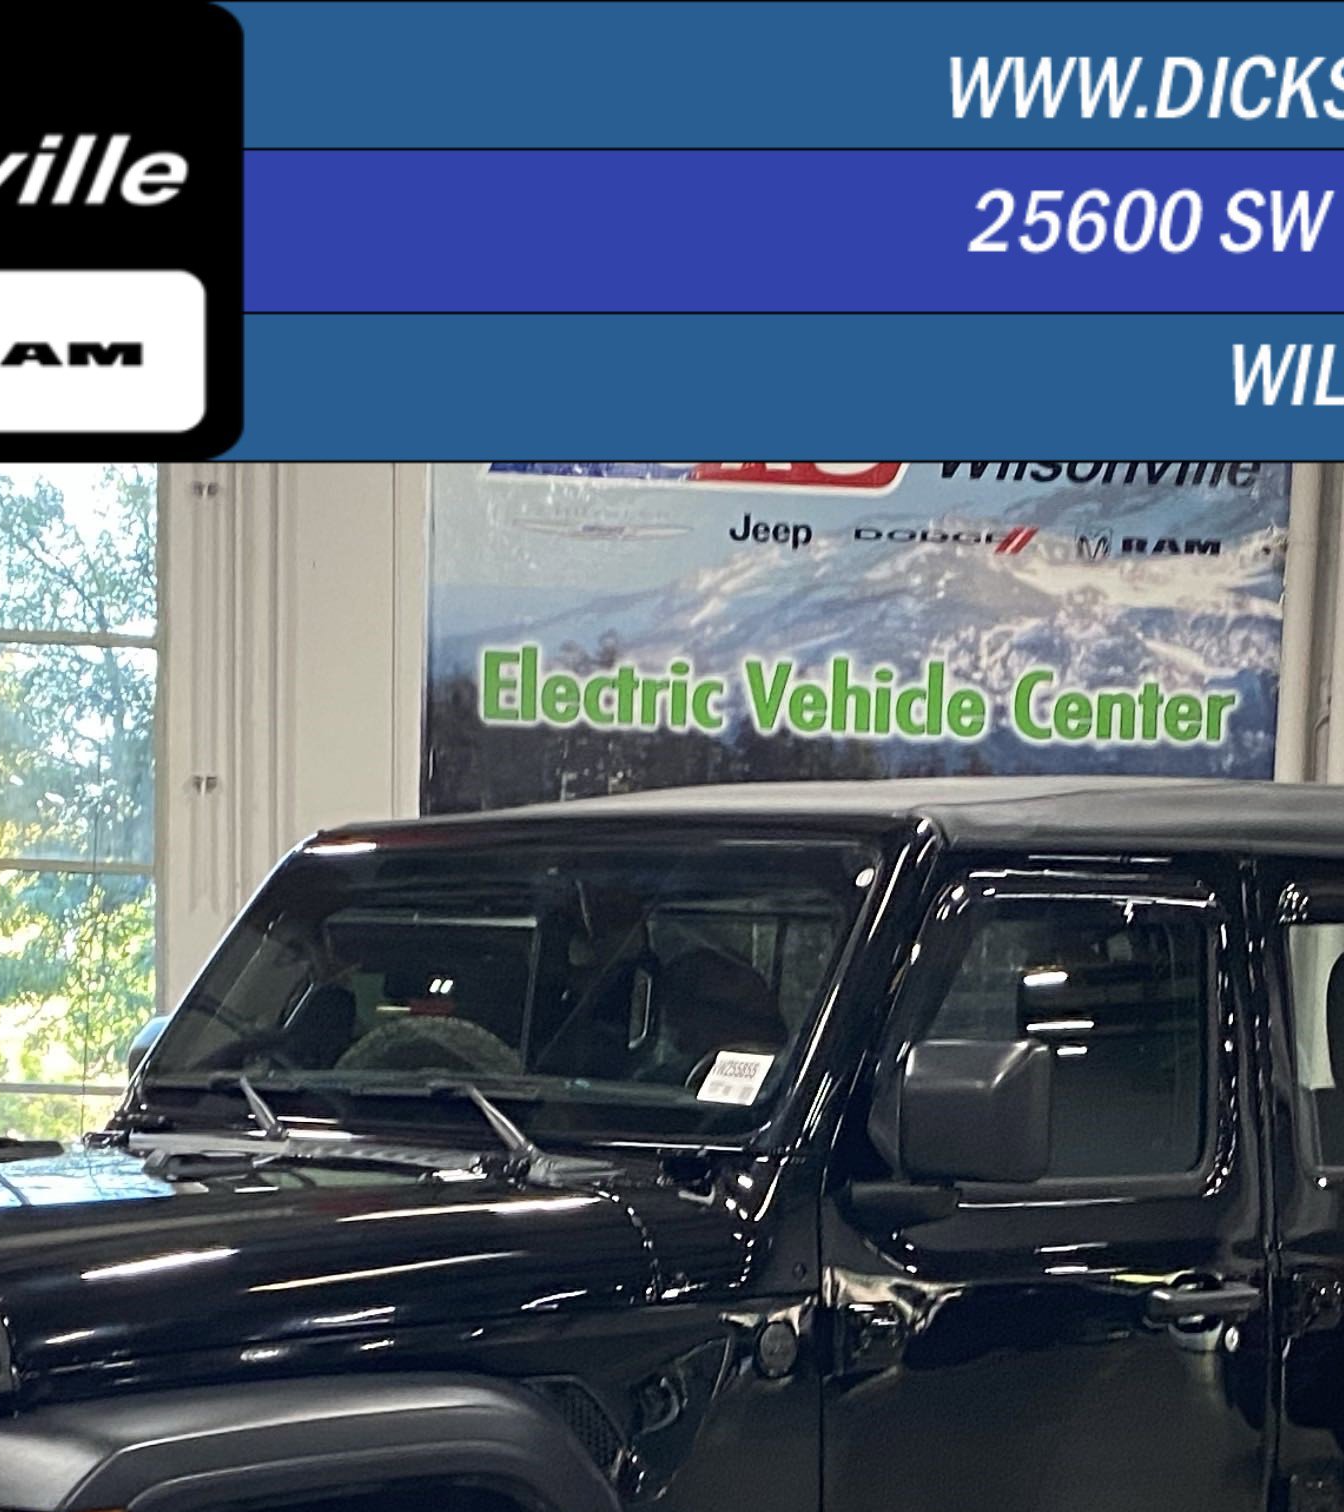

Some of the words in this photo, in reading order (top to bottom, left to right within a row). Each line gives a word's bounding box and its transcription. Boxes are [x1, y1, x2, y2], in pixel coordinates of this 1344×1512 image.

[729, 513, 812, 549] Jeep
[482, 646, 723, 729] Electric
[746, 657, 987, 737] Vehicle
[1013, 669, 1235, 742] Center
